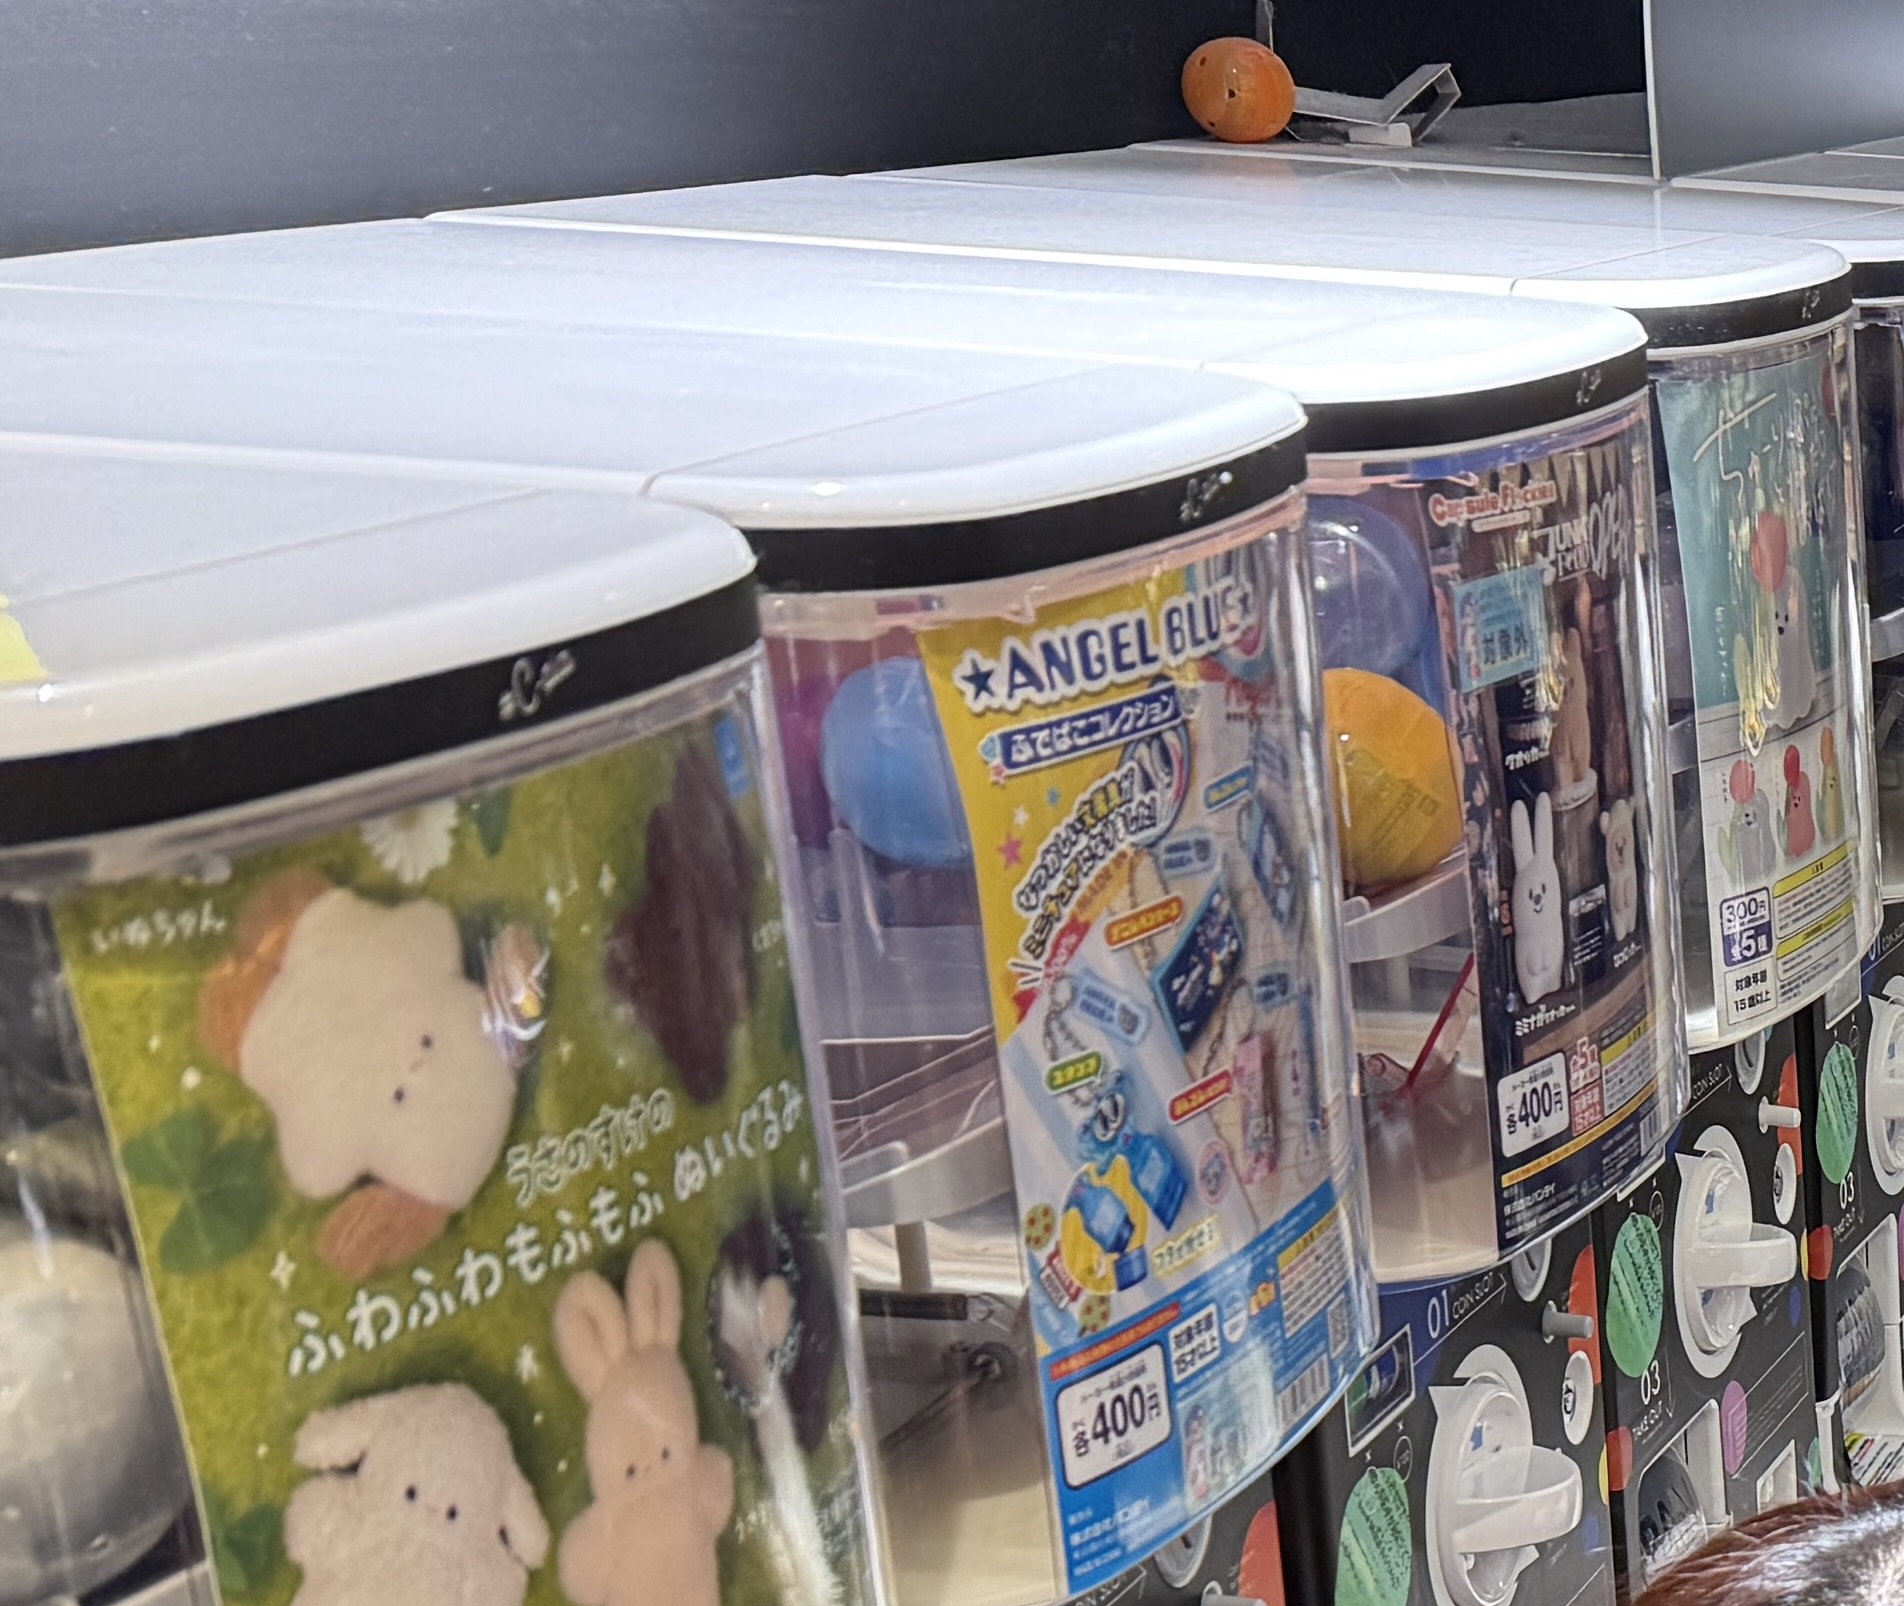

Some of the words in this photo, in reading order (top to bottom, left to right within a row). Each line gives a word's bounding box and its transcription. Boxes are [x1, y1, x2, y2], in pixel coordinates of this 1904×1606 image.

[1006, 617, 1160, 701] ANGEL
[1723, 897, 1768, 920] 300円
[1838, 1170, 1855, 1210] 03
[288, 1169, 667, 1379] ふわふわもふもふ
[1426, 1293, 1450, 1340] 01
[1640, 1360, 1662, 1406] 03
